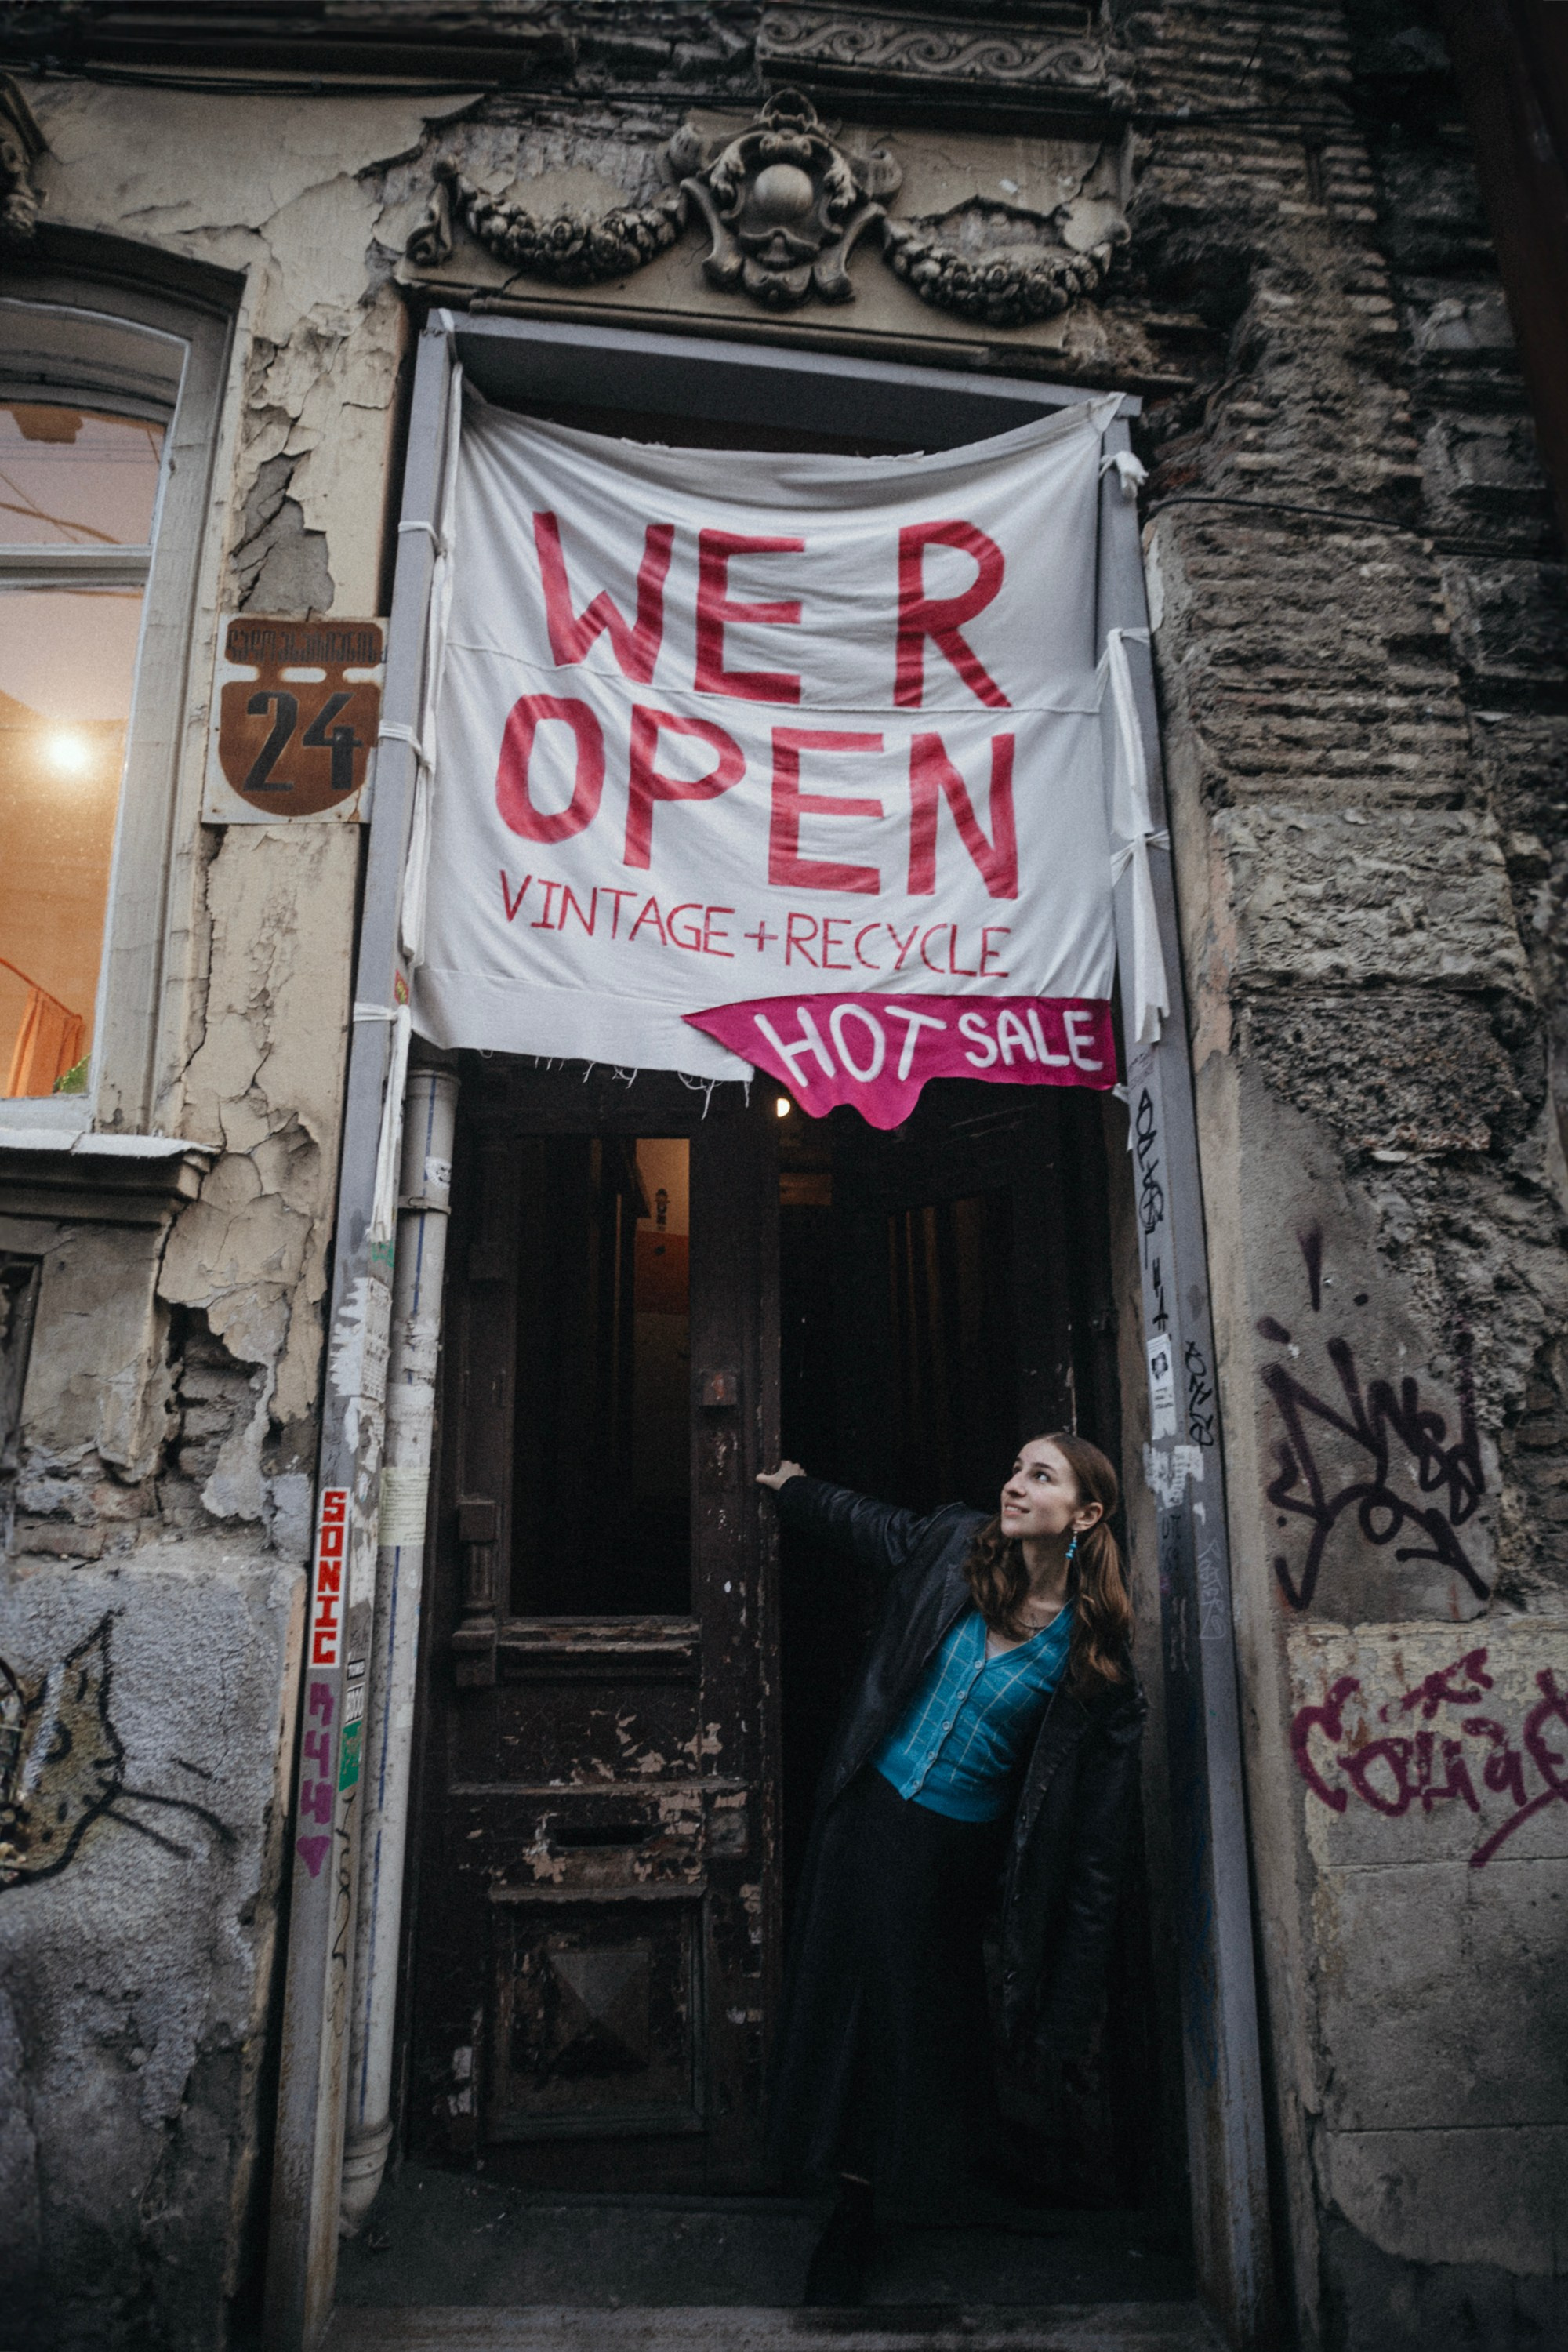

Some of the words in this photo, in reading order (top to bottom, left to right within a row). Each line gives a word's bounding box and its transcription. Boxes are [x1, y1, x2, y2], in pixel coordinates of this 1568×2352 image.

[532, 511, 805, 704] WE
[893, 520, 1014, 708] R
[242, 691, 364, 792] 24
[495, 694, 1019, 900] OPEN
[754, 1003, 946, 1088] HOT
[959, 1008, 1104, 1072] SALE
[311, 1491, 347, 1665] SONIC
